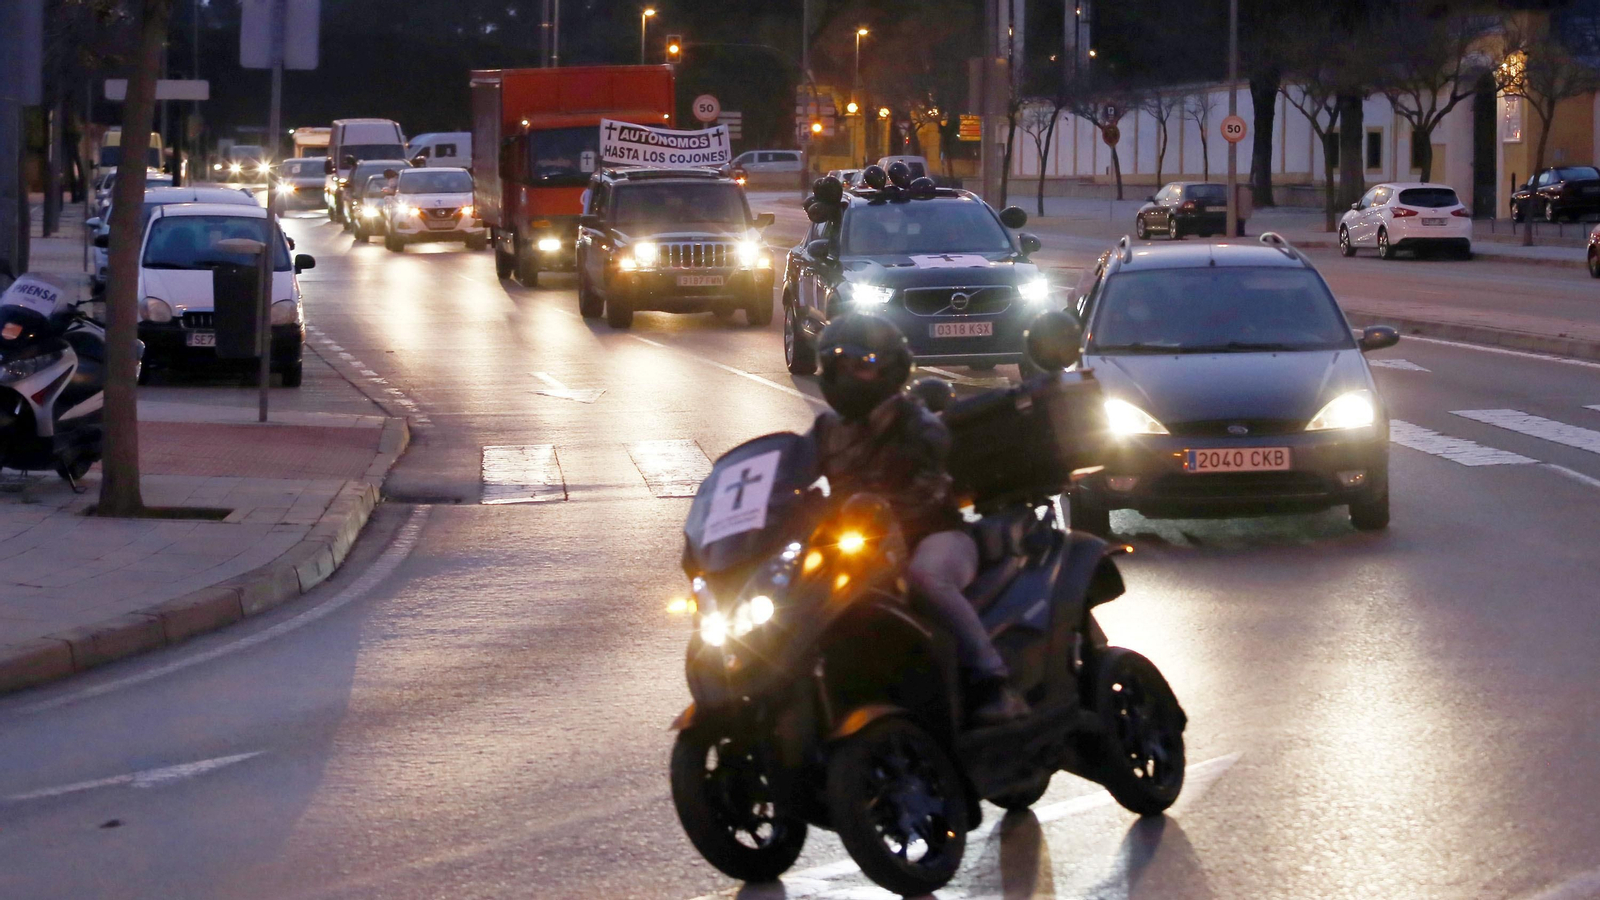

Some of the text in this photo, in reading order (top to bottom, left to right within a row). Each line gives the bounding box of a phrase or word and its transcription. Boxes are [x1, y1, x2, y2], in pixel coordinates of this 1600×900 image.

[700, 104, 714, 113] 50
[1227, 124, 1241, 134] 50
[604, 145, 728, 164] HASTA LOS COJONES!
[12, 284, 58, 304] PRENSA
[937, 324, 966, 336] 0318
[1198, 450, 1285, 468] 2040 CKB
